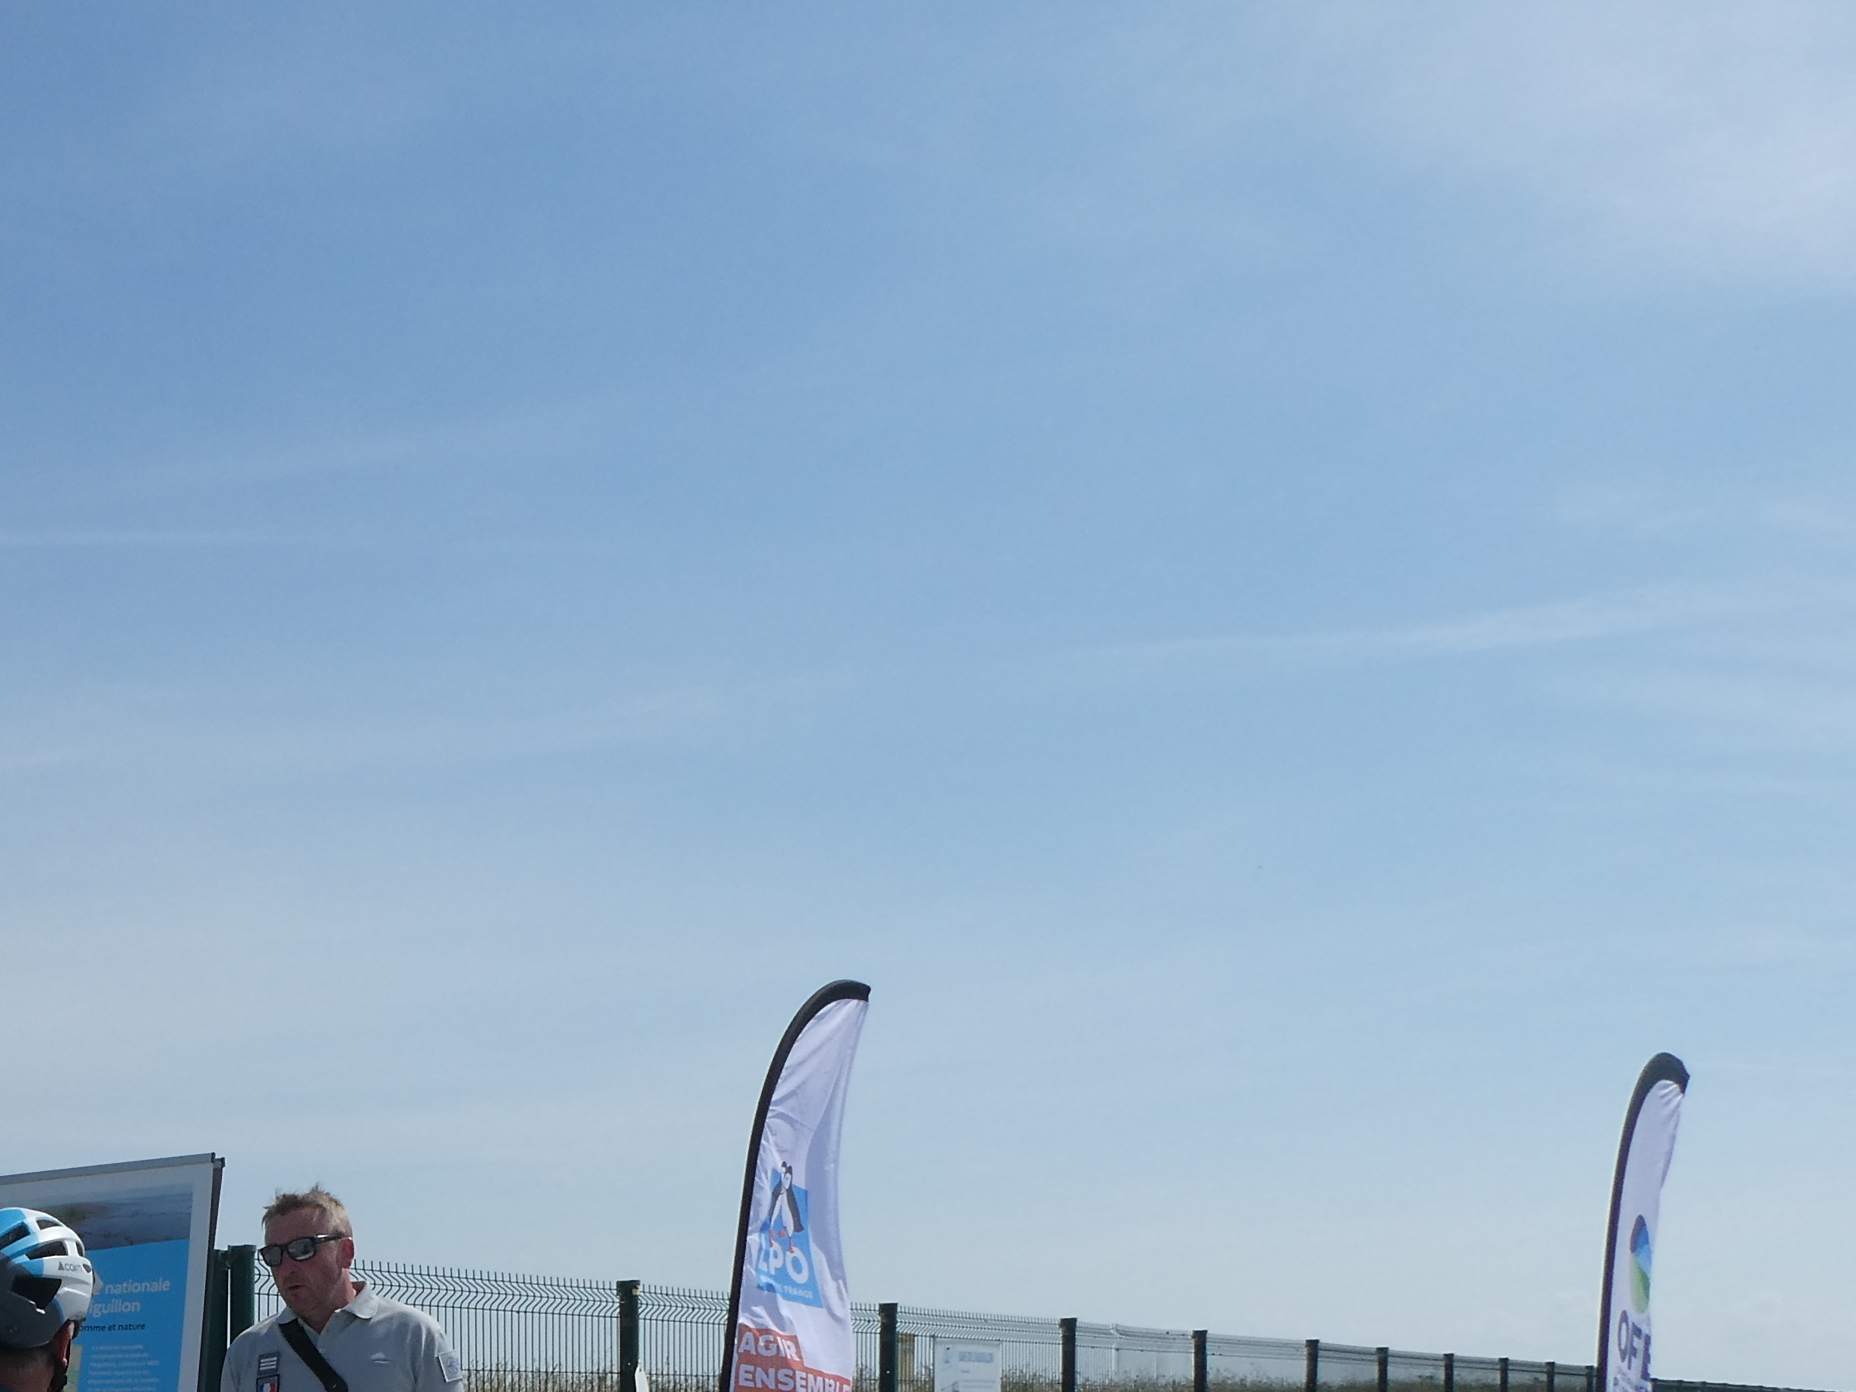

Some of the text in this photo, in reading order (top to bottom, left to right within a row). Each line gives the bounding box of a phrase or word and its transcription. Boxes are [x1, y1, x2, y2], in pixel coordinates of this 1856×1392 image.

[758, 1238, 809, 1285] LPO
[105, 1278, 170, 1294] nationale
[107, 1324, 116, 1332] et
[118, 1322, 145, 1331] nature
[738, 1331, 801, 1361] AGIR
